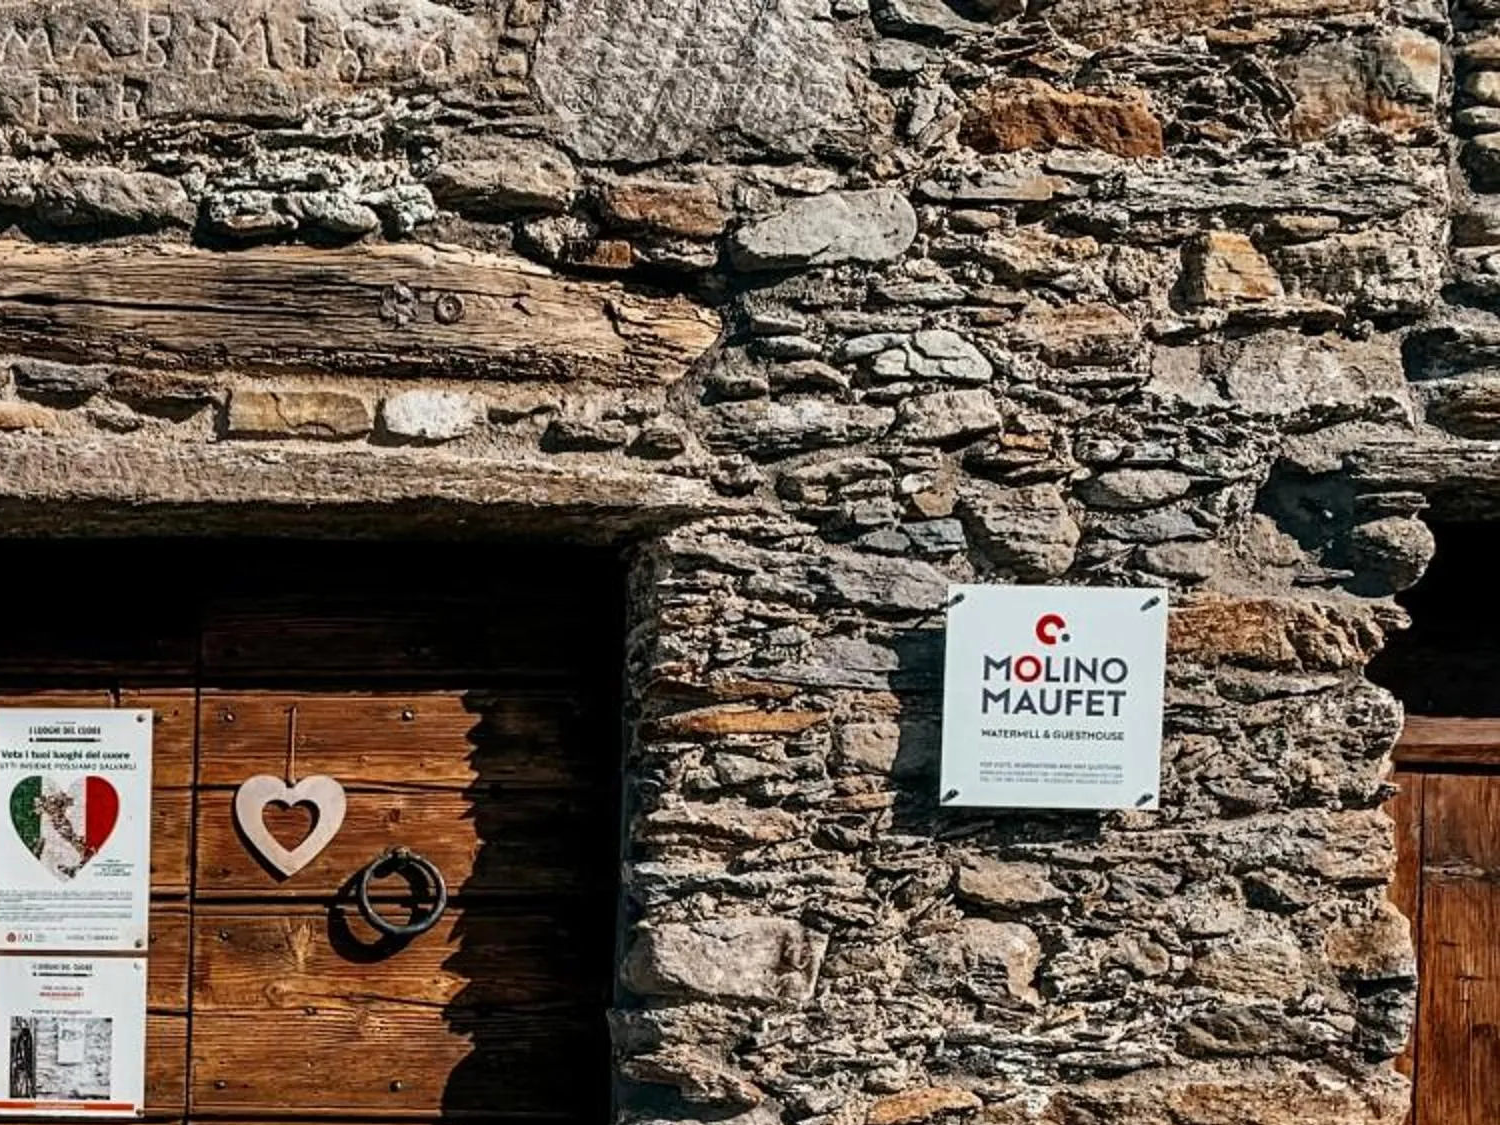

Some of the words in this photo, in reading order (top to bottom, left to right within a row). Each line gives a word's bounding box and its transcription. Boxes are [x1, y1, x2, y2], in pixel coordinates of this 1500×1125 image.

[983, 654, 1129, 684] MOLINO
[981, 687, 1127, 717] MAUFET
[980, 728, 1041, 739] WATERMILL
[1043, 730, 1051, 739] &
[1053, 730, 1125, 741] GUESTHOUSE
